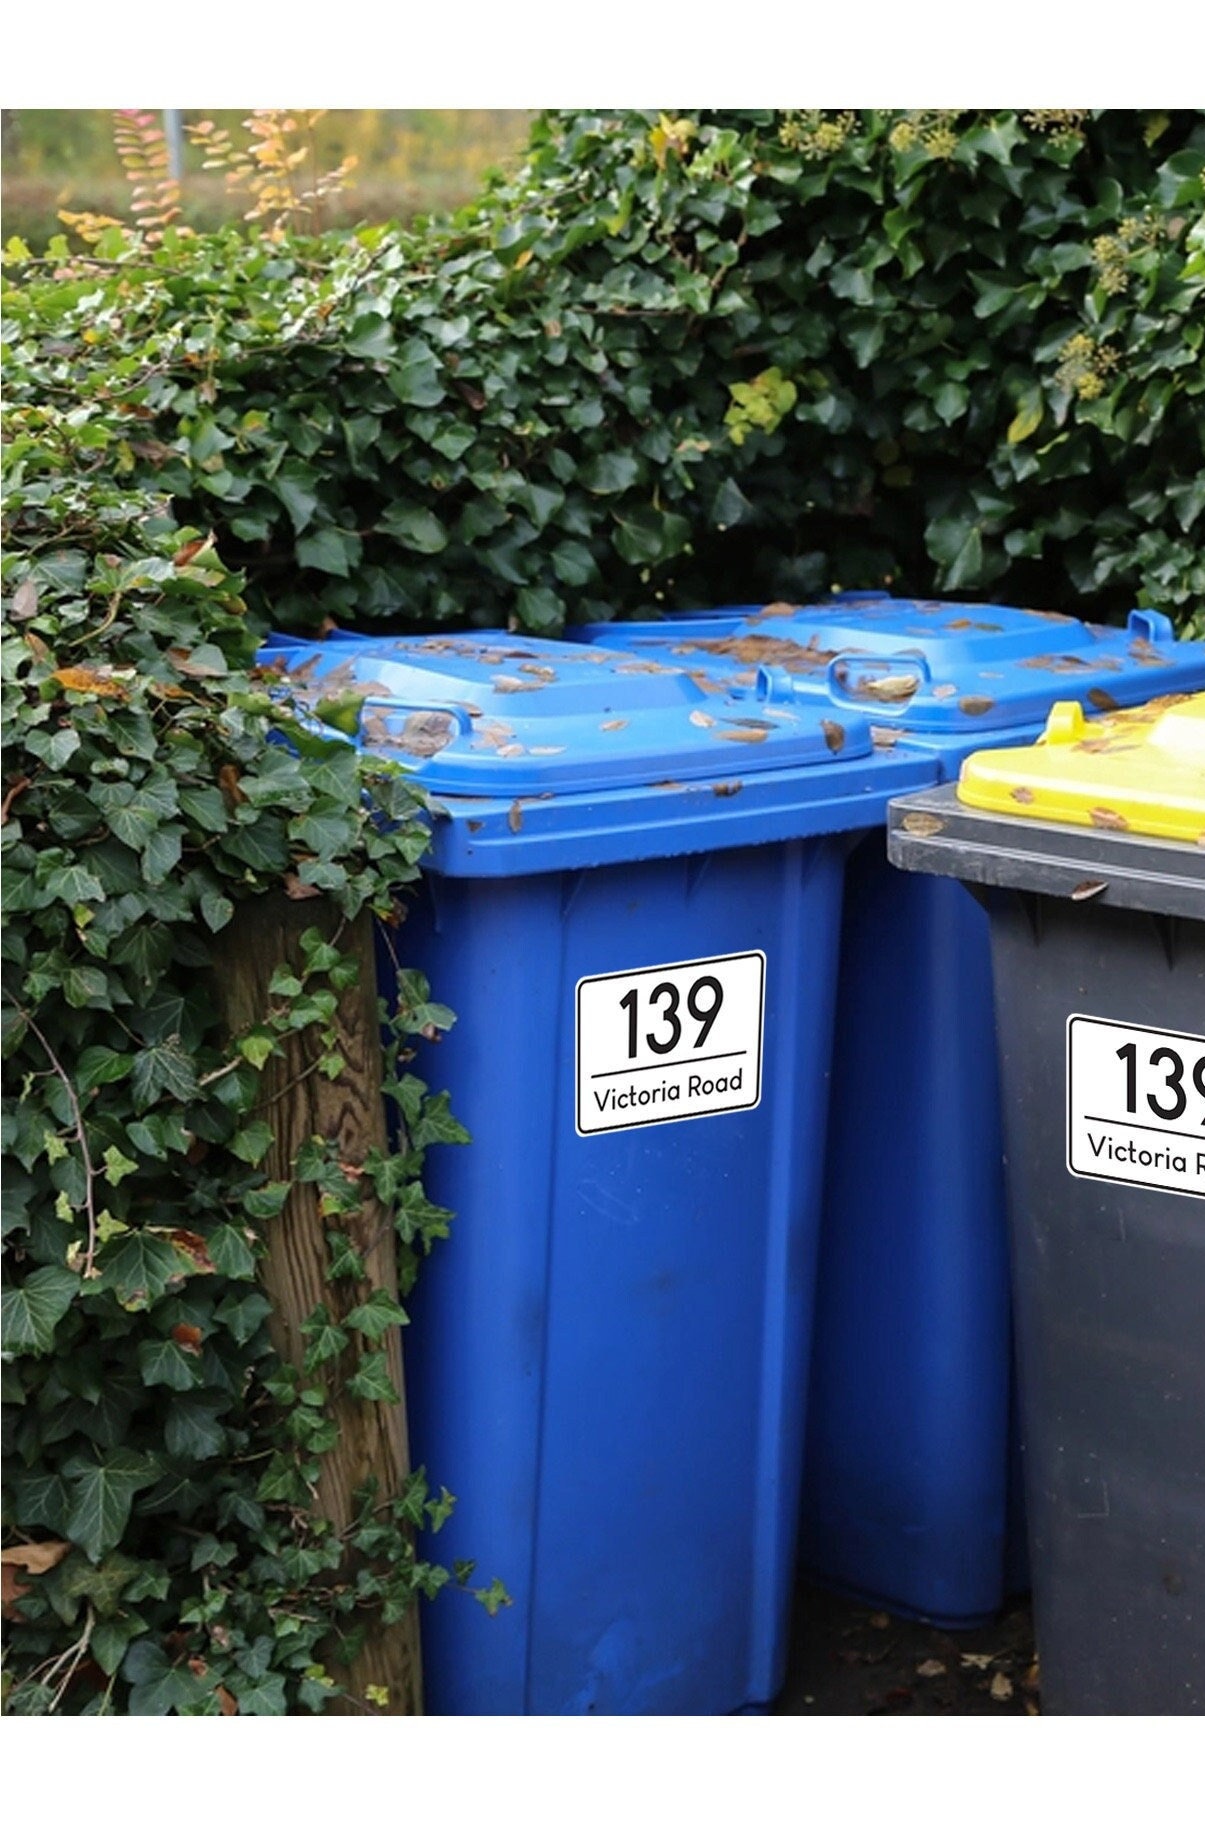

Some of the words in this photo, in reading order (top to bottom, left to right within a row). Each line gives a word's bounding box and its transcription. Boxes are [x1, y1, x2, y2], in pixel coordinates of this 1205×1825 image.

[620, 976, 723, 1058] 139
[594, 1081, 680, 1112] Victoria
[689, 1068, 743, 1097] Road
[1088, 1133, 1187, 1172] Victoria
